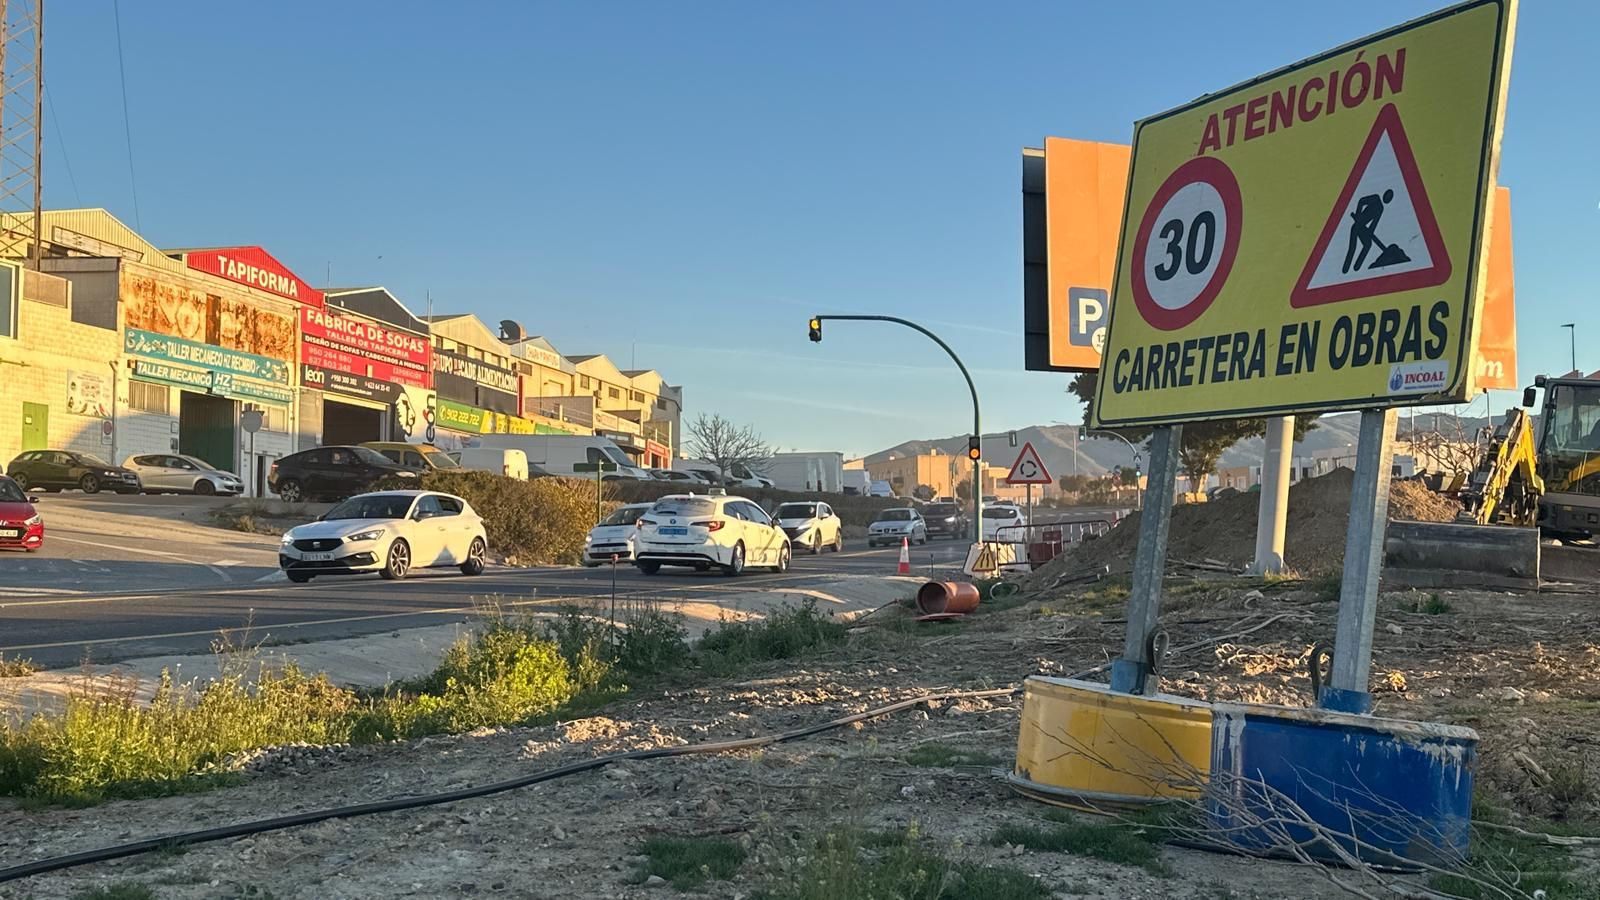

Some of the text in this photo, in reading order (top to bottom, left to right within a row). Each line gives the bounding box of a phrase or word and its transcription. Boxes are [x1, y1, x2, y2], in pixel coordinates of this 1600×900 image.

[1197, 48, 1406, 157] ATENCIÓN
[1154, 210, 1216, 281] 30
[217, 255, 298, 297] TAPIFORMA
[306, 310, 424, 353] FABRICA DE SOFAS
[1079, 298, 1103, 334] P
[167, 341, 190, 360] TALLER
[326, 330, 357, 345] TALLER
[330, 342, 340, 350] DE
[340, 344, 360, 356] SOFAS
[1113, 300, 1450, 394] CARRETERA EN OBRAS
[137, 361, 231, 387] TALLER MECANICO HZ
[1404, 371, 1445, 384] INCOAL
